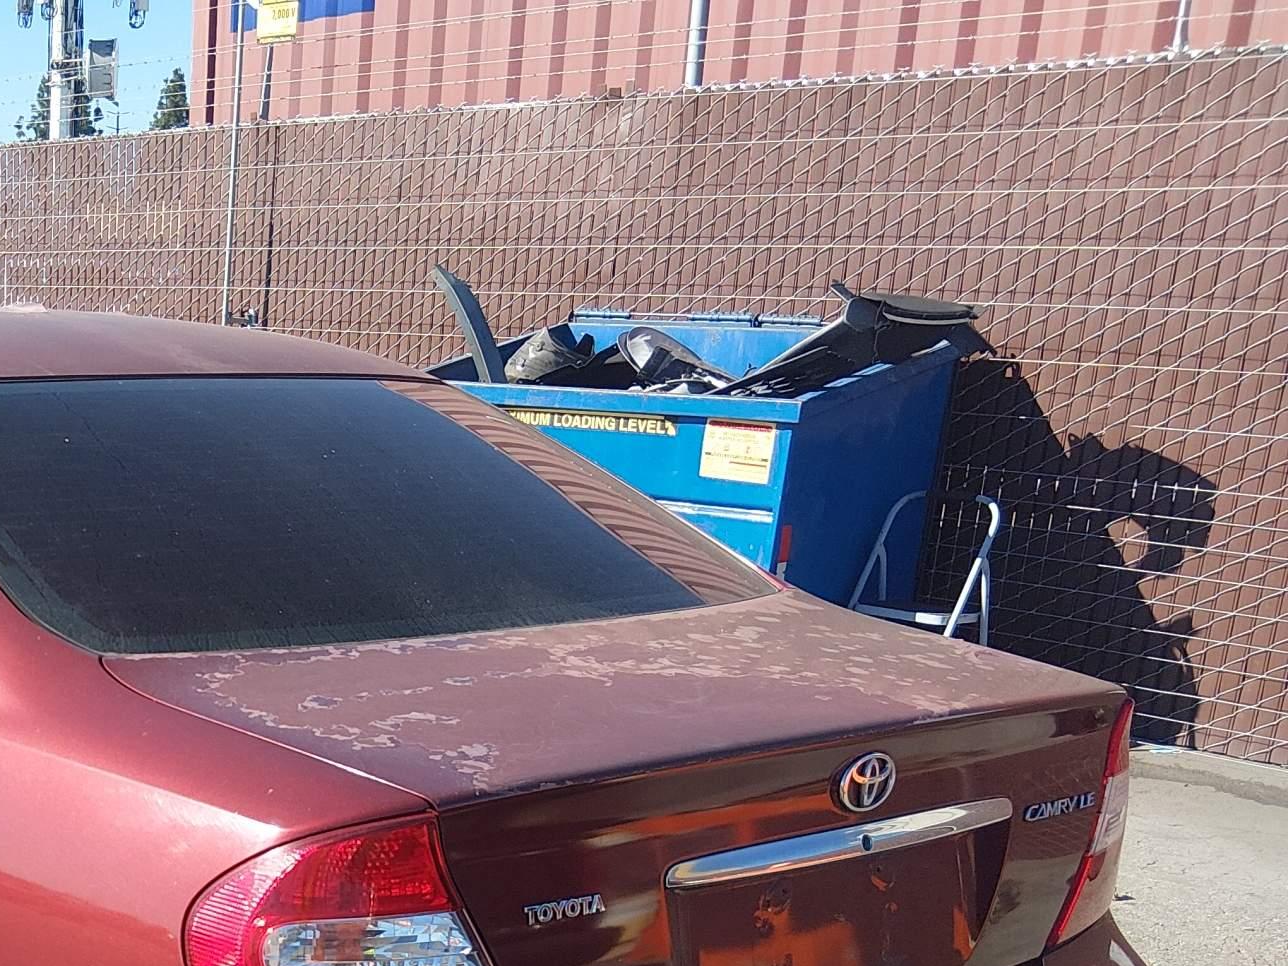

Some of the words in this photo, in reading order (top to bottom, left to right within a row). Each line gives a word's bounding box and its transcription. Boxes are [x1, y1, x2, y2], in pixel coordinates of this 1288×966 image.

[553, 414, 616, 431] LOADING
[619, 418, 666, 434] LEVEL
[1024, 795, 1078, 821] CAMRY
[1079, 791, 1096, 809] LE
[524, 893, 606, 926] TOYOTA
